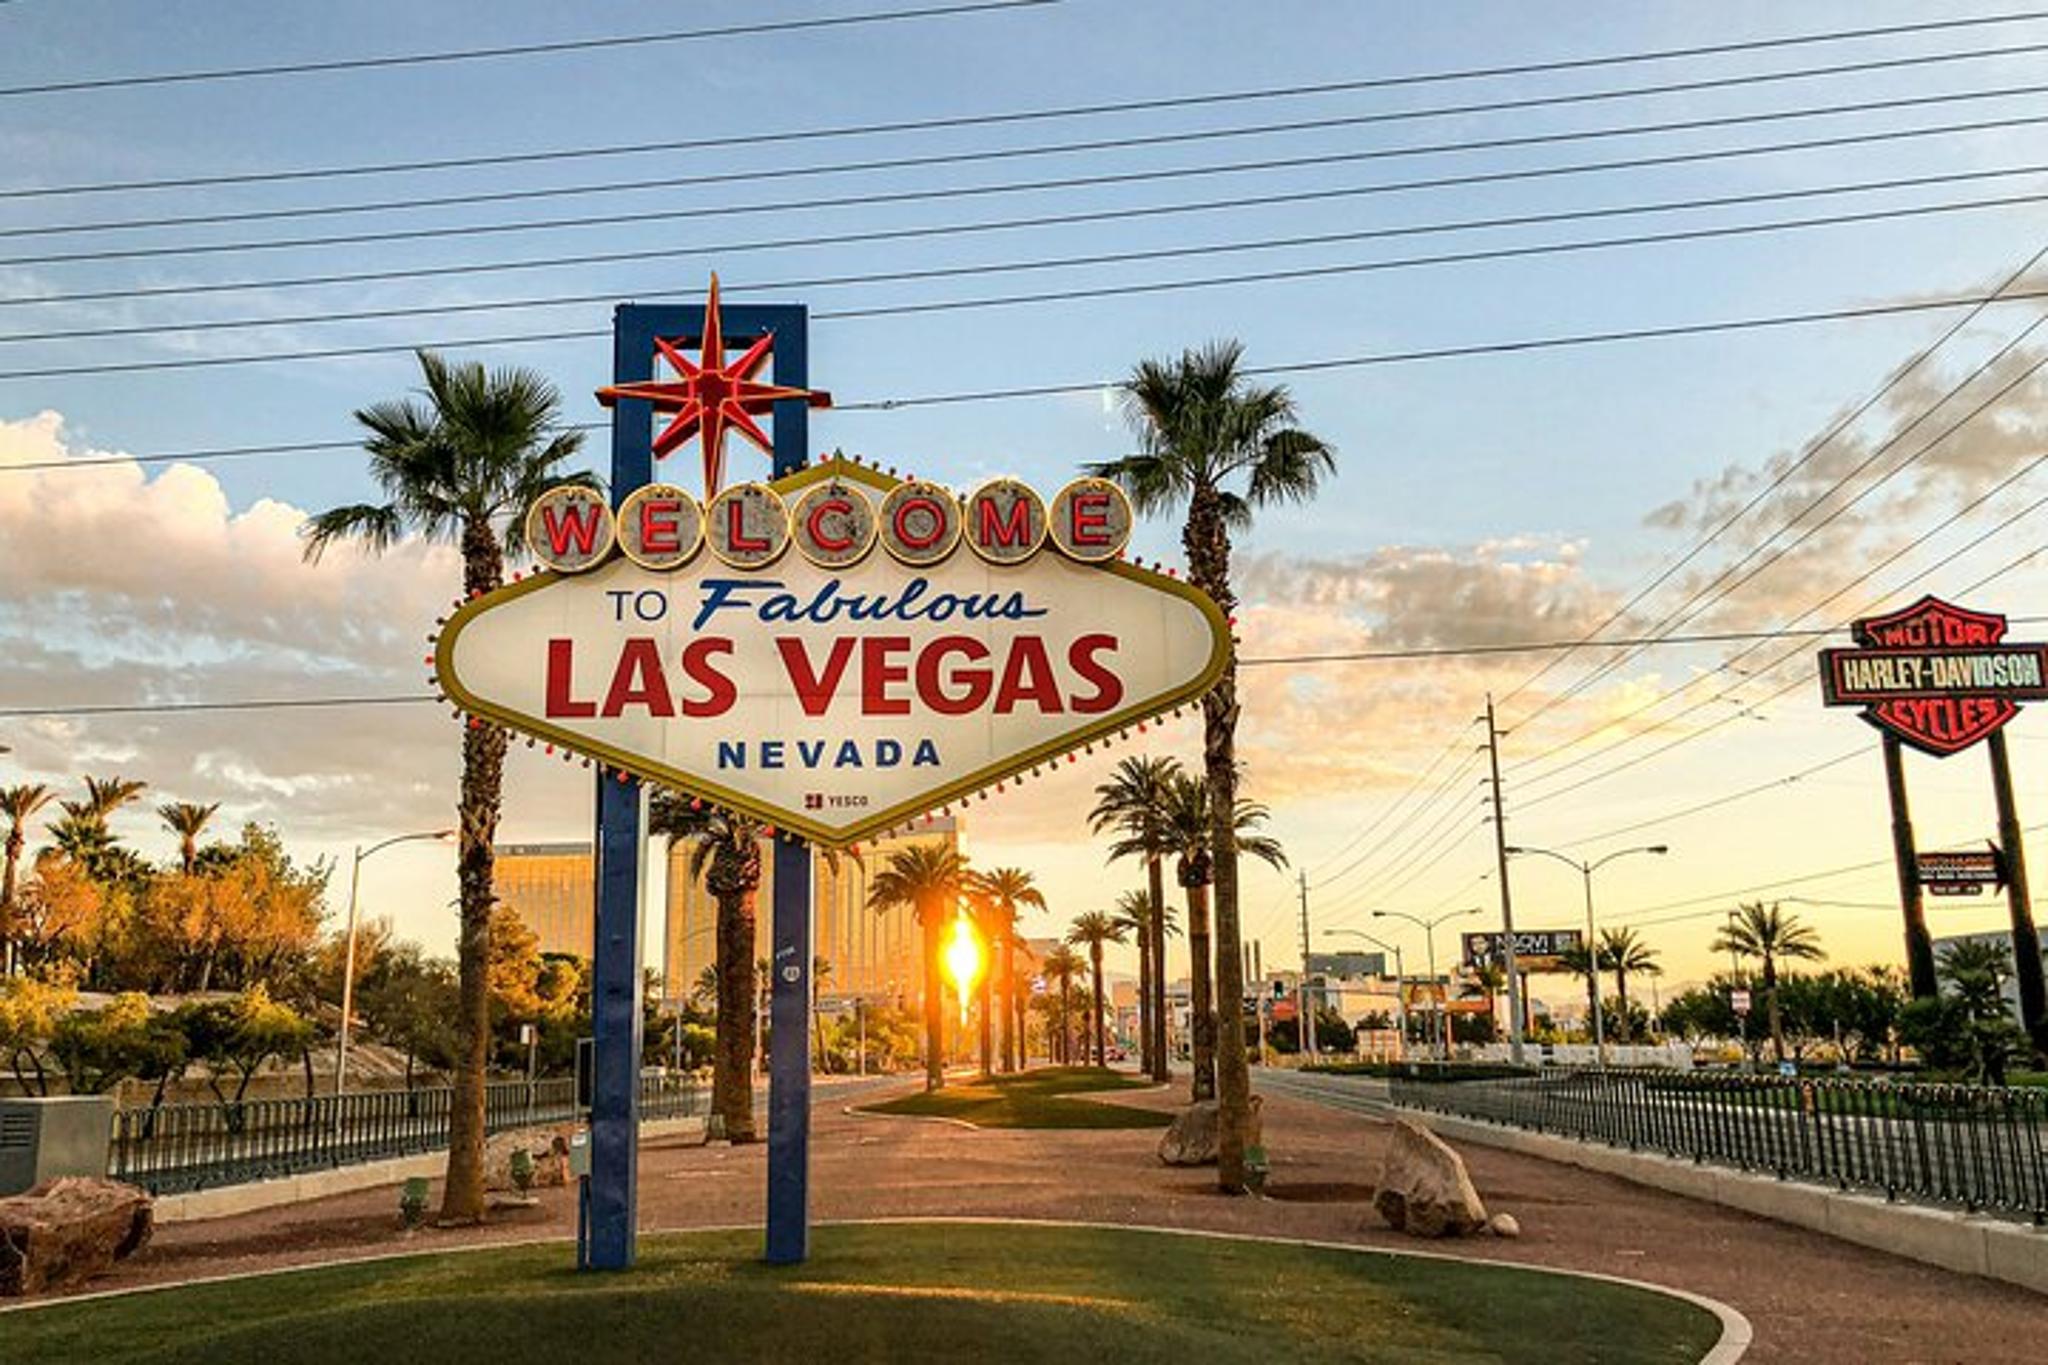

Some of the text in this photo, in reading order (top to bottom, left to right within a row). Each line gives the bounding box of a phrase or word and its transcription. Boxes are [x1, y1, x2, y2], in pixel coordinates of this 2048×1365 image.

[541, 491, 1113, 557] WELCOME
[606, 578, 1048, 630] TO Fabulous
[1885, 611, 1990, 646] MOTOR
[545, 634, 1125, 718] LAS VEGAS
[1843, 654, 2042, 691] HARLEY-DAVIDSON
[1893, 697, 1998, 741] CYCLES
[717, 738, 941, 769] NEVADA
[828, 795, 868, 808] YESCO
